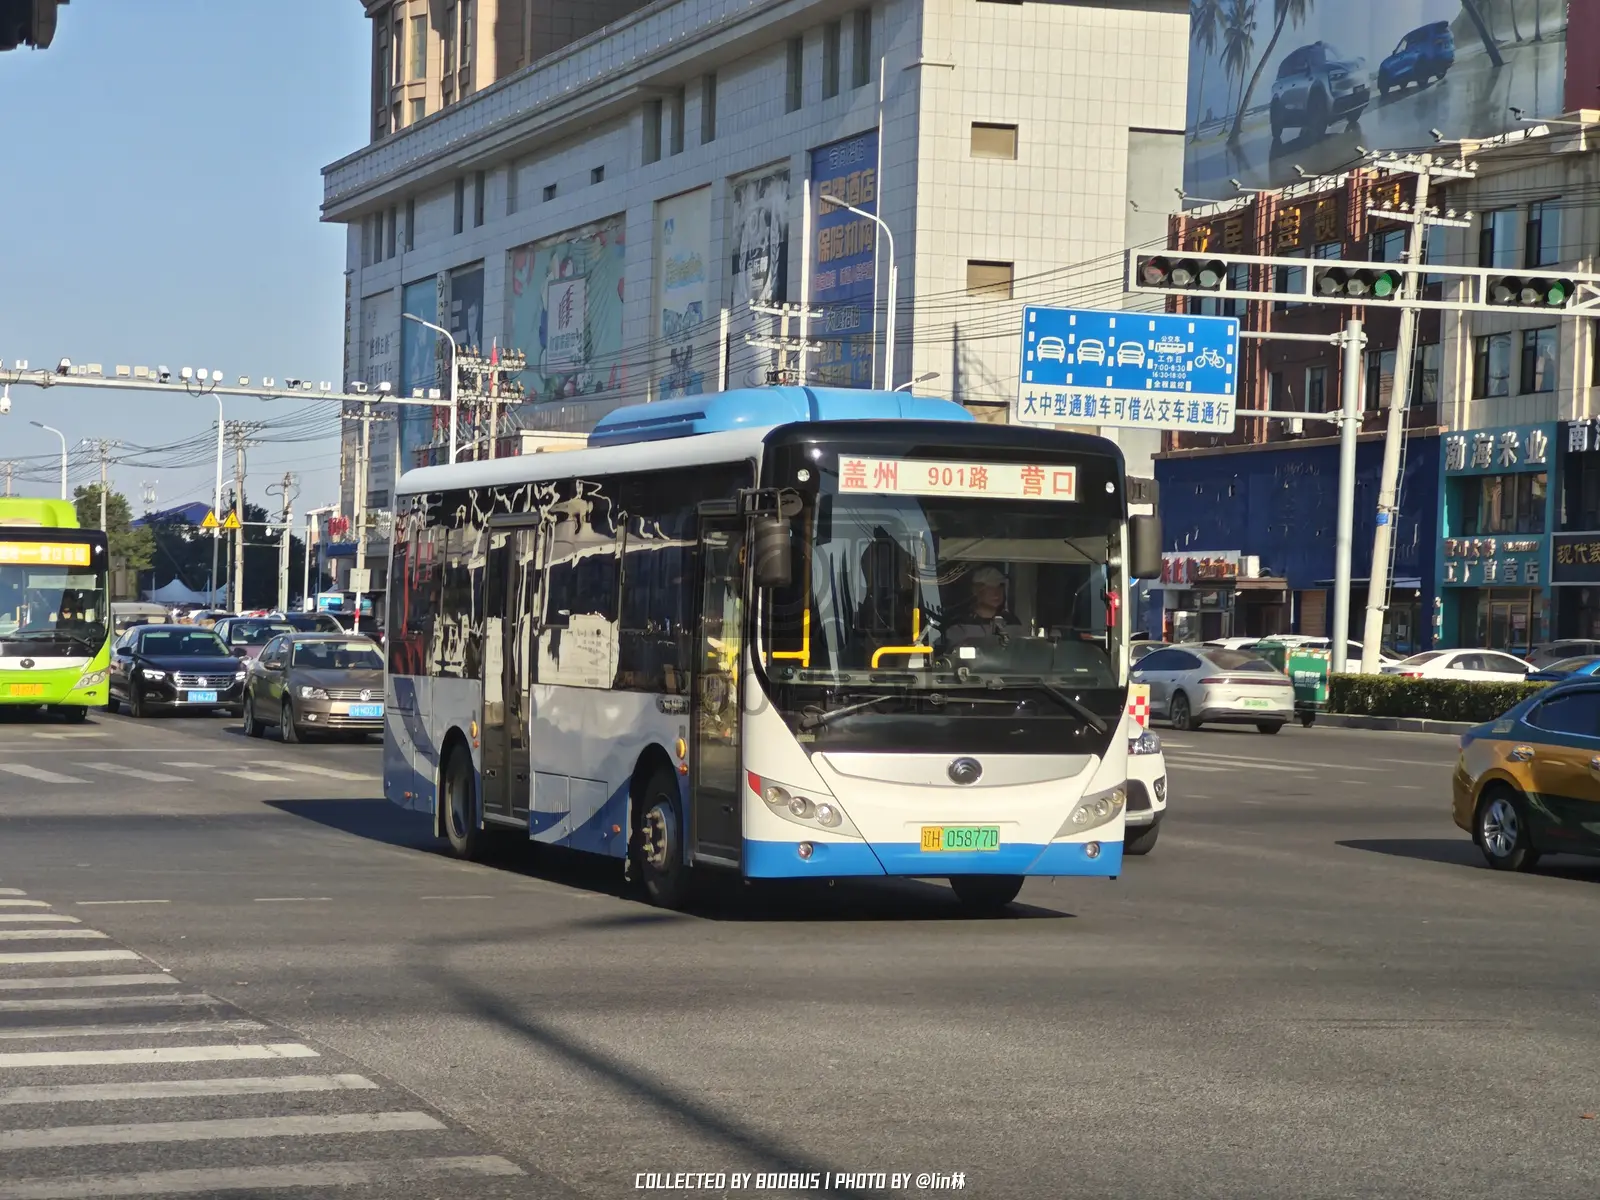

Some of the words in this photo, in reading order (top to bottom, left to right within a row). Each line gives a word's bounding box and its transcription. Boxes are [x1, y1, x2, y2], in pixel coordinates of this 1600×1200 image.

[1160, 335, 1181, 343] 公交车
[1157, 355, 1183, 364] 工作日
[1153, 363, 1186, 372] 7:00-8:30
[1153, 380, 1185, 389] 全程监控
[1023, 390, 1230, 426] 大中型通勤车可借公交车道通行
[841, 460, 898, 491] 盖州
[928, 466, 989, 490] 901路
[1021, 465, 1074, 496] 营口
[1443, 558, 1540, 584] 工厂直营店
